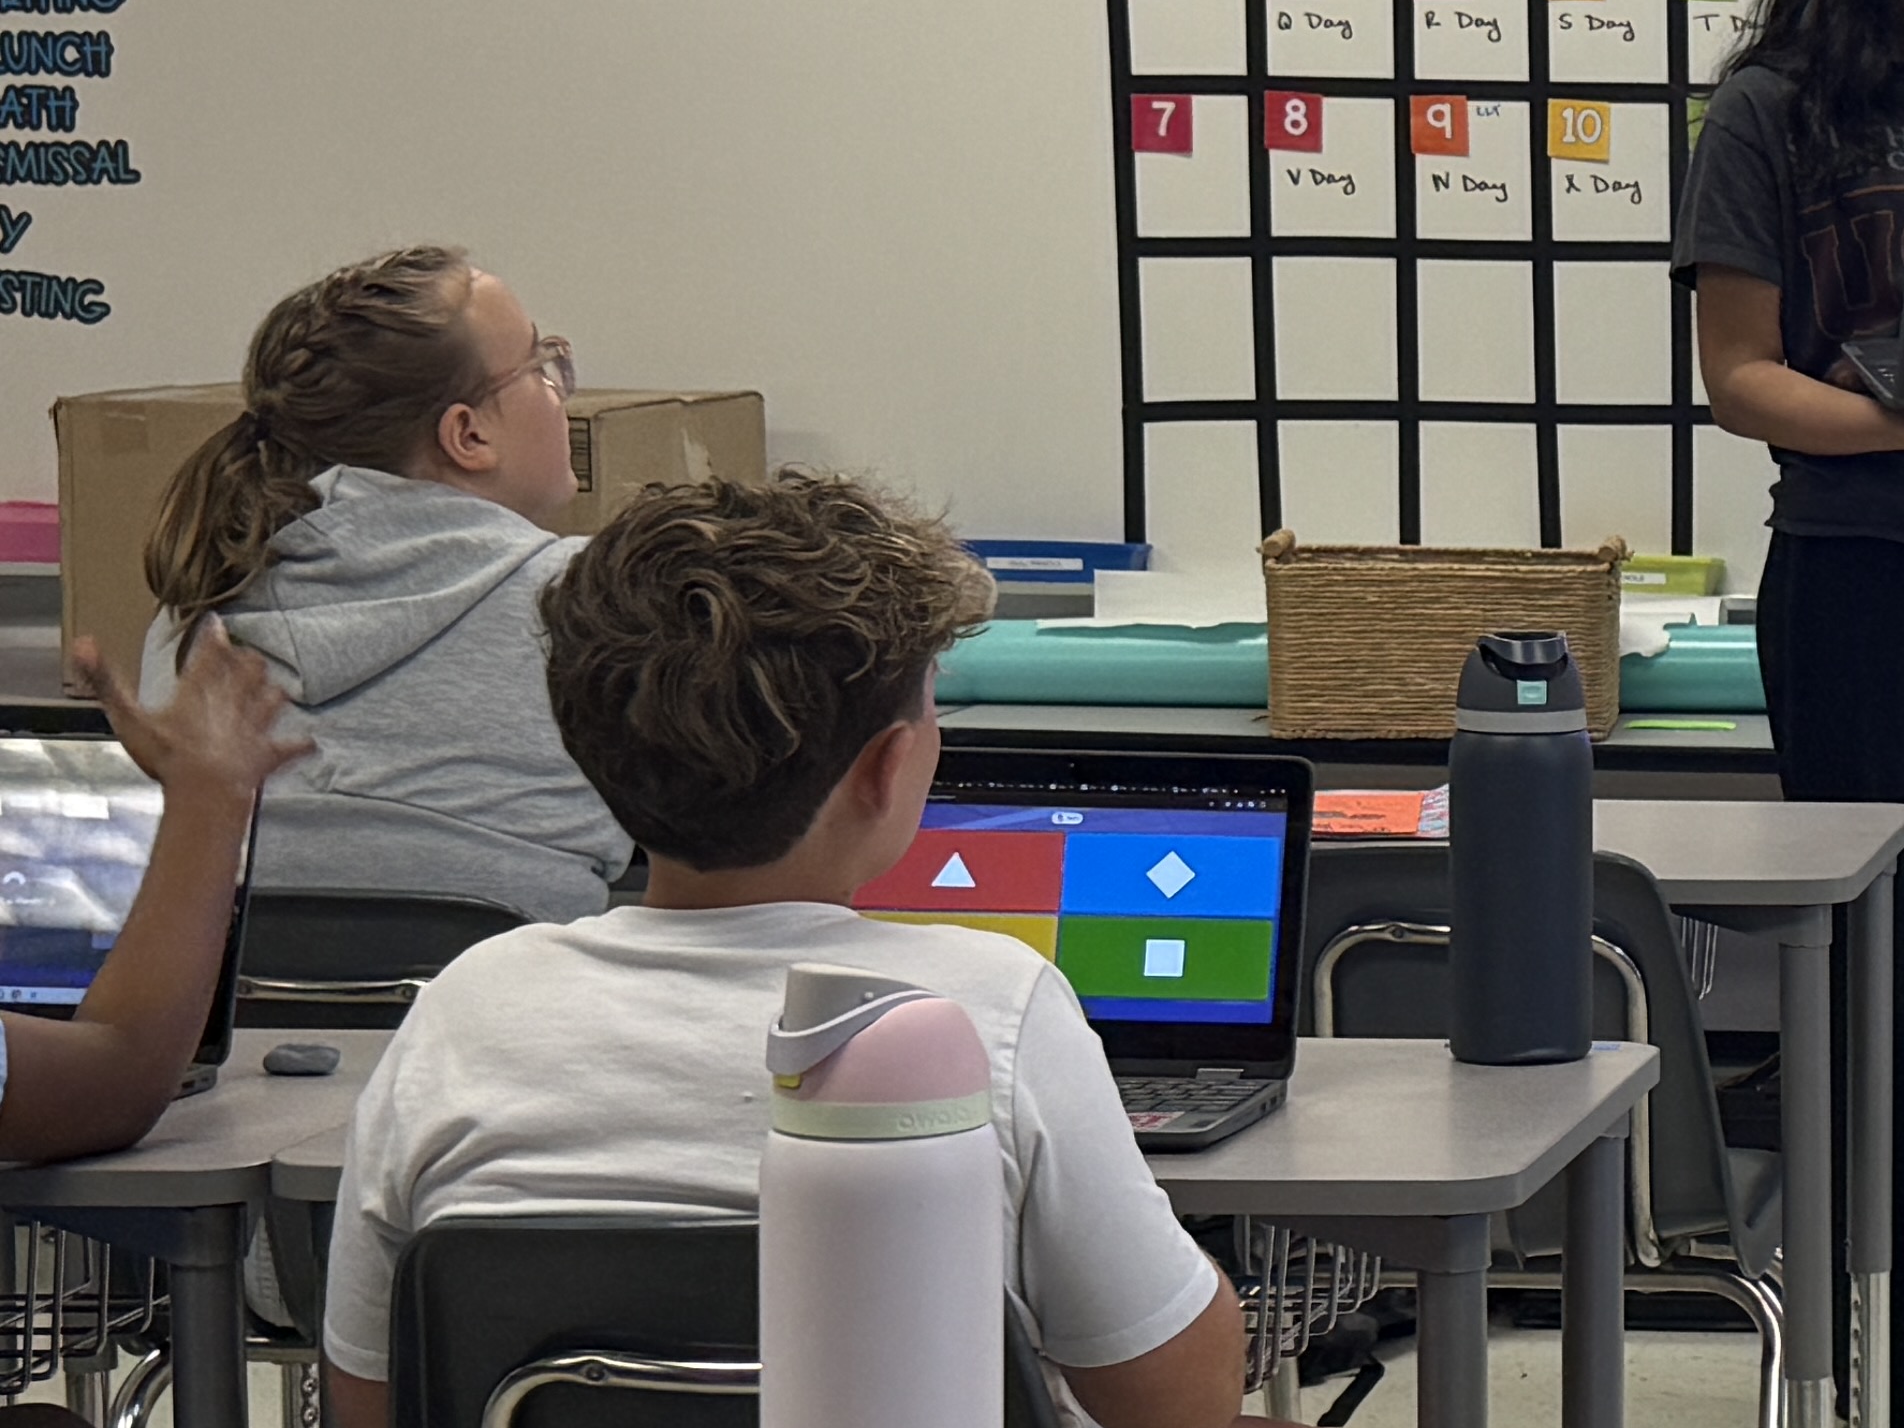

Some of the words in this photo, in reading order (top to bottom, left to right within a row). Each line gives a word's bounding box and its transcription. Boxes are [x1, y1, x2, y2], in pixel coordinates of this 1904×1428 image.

[0, 31, 114, 78] UNCH
[1151, 100, 1175, 136] 7
[1283, 99, 1308, 135] 8
[1427, 103, 1452, 139] 9
[1562, 107, 1602, 144] 10
[0, 140, 141, 186] MISSAL
